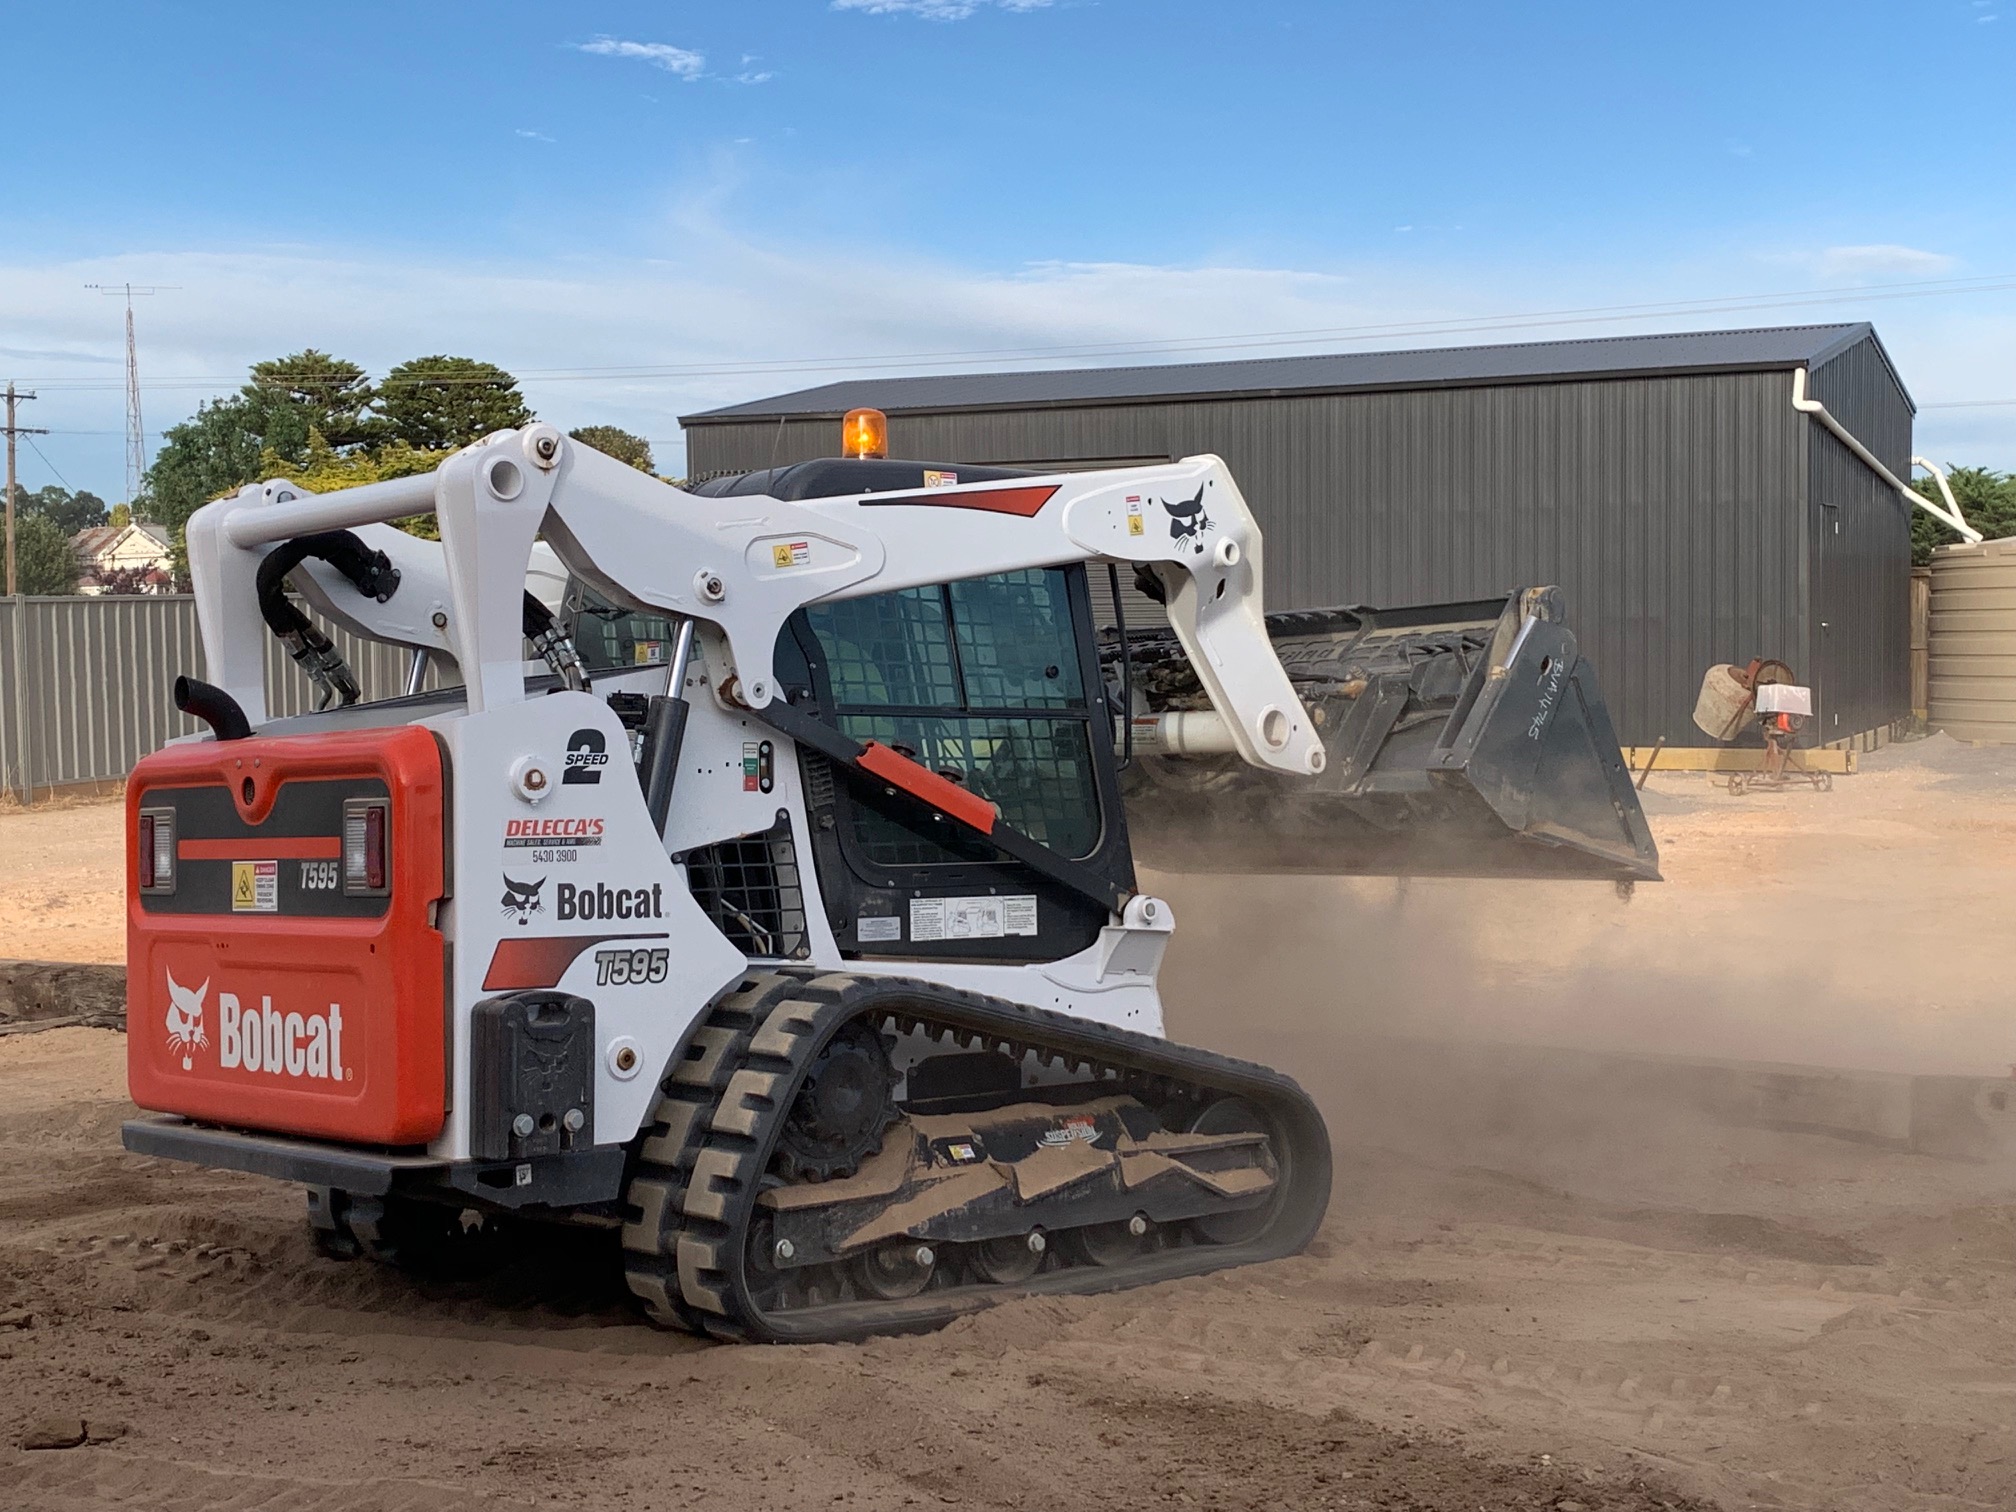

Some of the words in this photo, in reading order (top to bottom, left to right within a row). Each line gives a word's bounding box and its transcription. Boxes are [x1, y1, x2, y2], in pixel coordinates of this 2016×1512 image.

[565, 753, 609, 766] SPEED
[506, 818, 605, 837] DELECCA'S
[532, 850, 554, 863] 5430
[556, 849, 577, 862] 3900
[300, 861, 338, 890] T595
[557, 882, 662, 921] Bobcat
[595, 948, 670, 986] T595
[219, 992, 343, 1081] Bobcat
